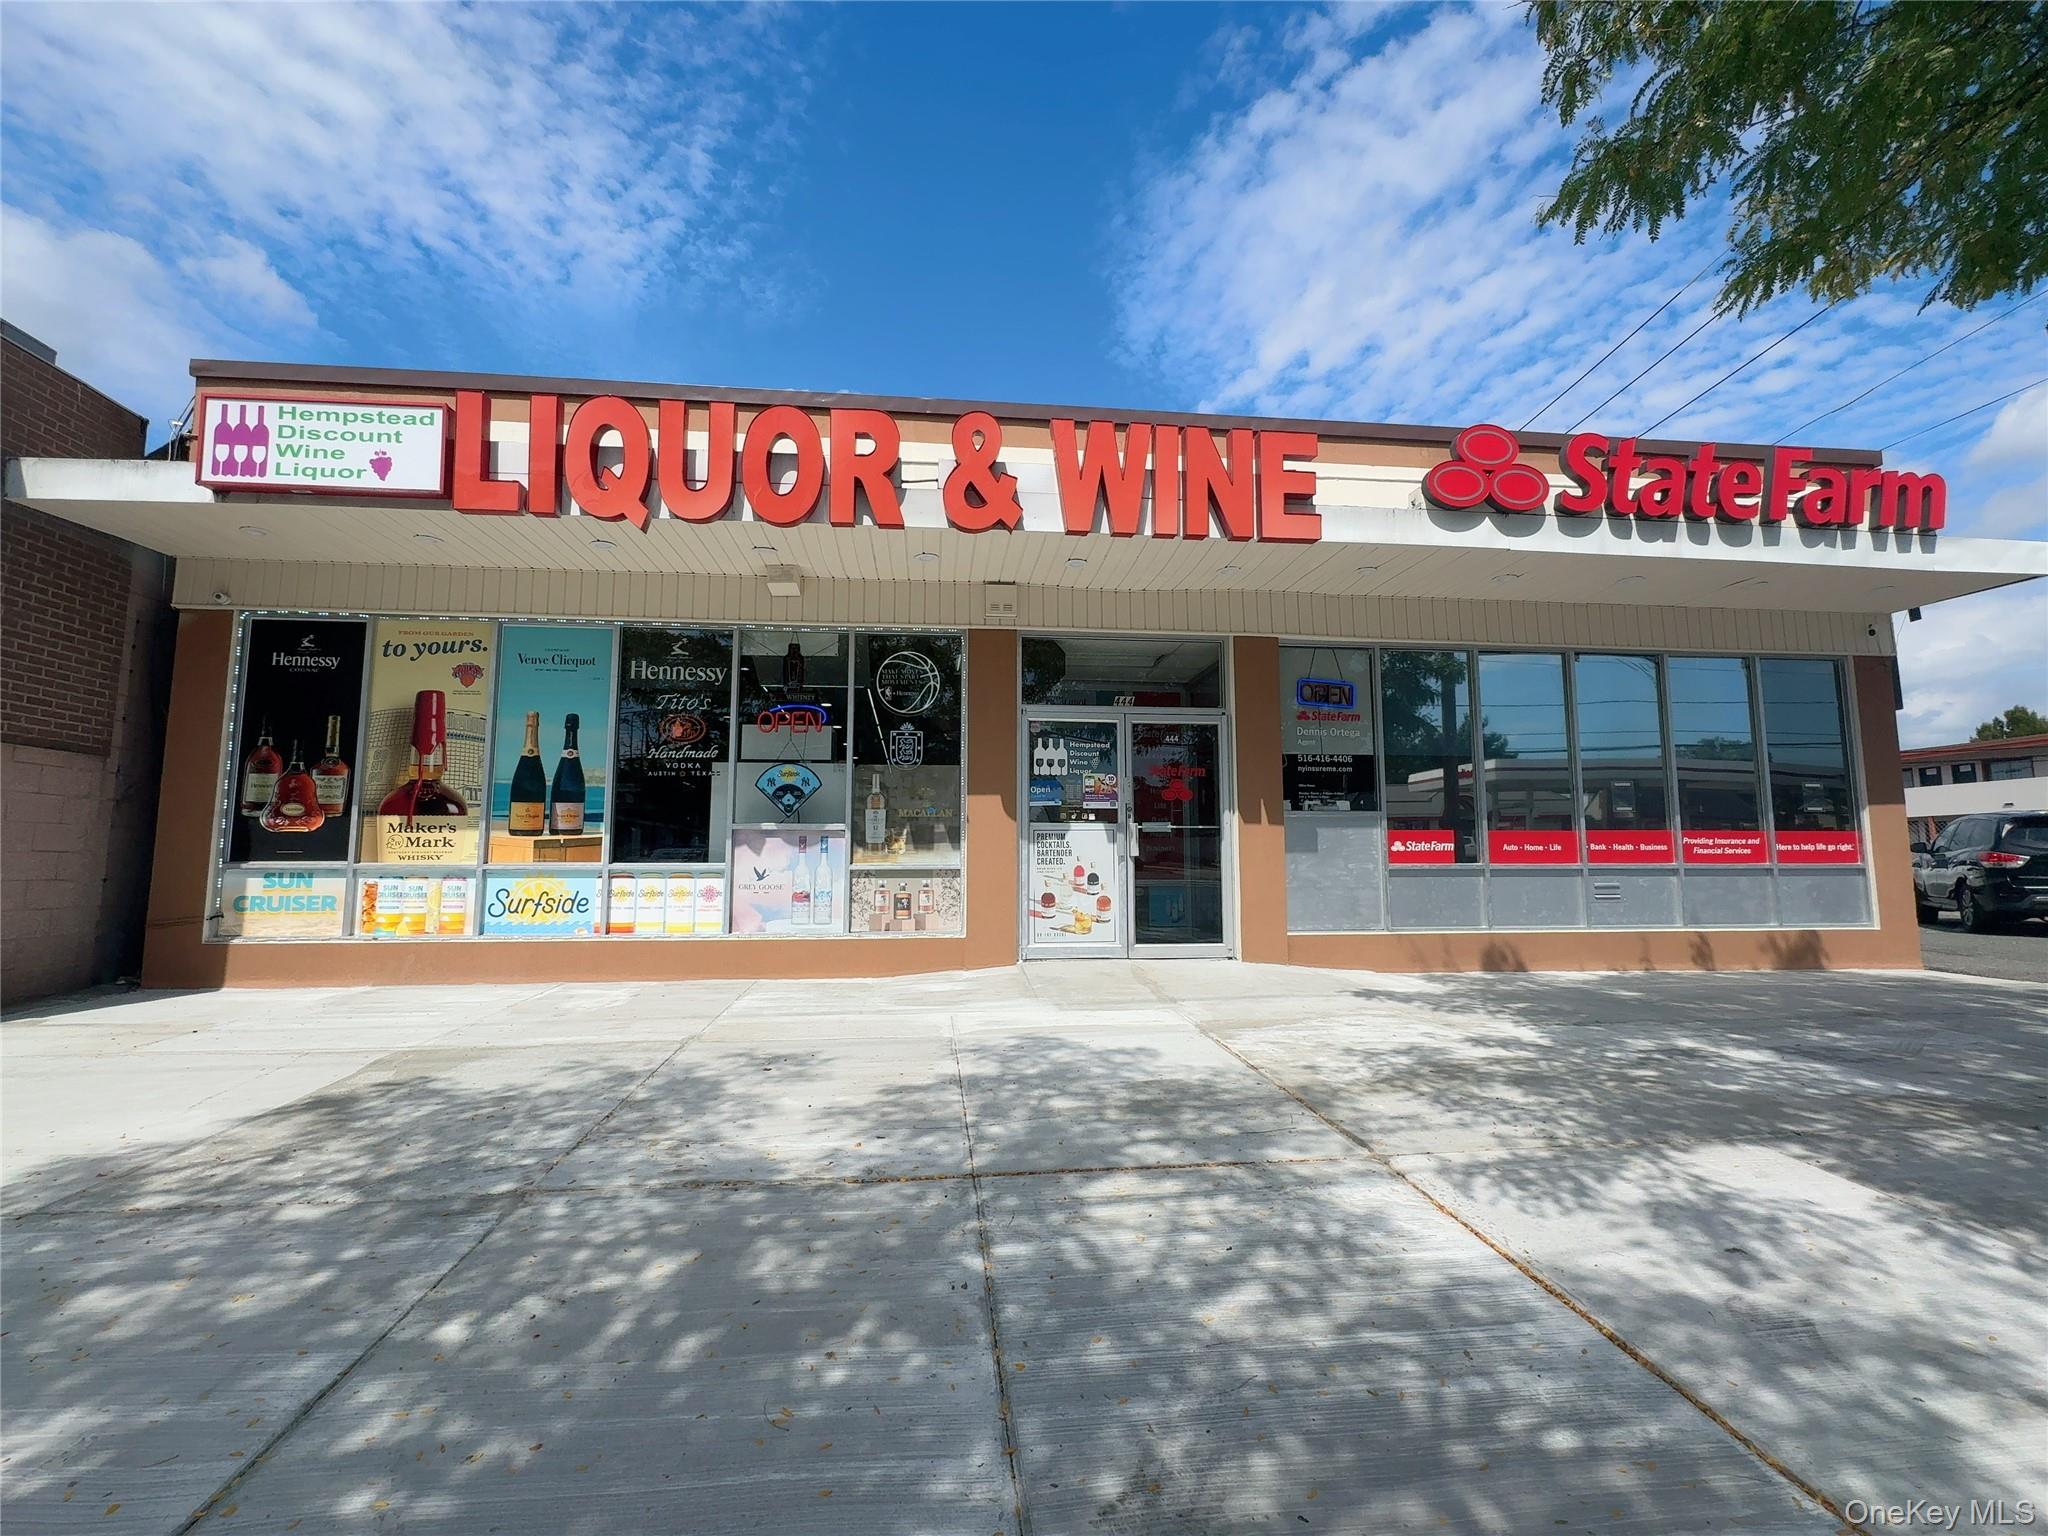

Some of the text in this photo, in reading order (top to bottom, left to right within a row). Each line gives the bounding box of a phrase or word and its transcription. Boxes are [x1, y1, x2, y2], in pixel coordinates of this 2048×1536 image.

[278, 405, 435, 427] Hempstead
[277, 425, 403, 444] Discount
[276, 443, 346, 460] Wine
[274, 462, 367, 481] Liquor
[453, 389, 1323, 545] LIQUOR & WINE
[382, 639, 488, 661] to yours.
[272, 652, 341, 670] Hennessy
[518, 653, 596, 668] Veuve Clicquot
[630, 660, 728, 686] Hennessy
[1113, 696, 1135, 706] 444
[1301, 684, 1351, 705] OPEN
[656, 693, 712, 710] Tito's
[757, 711, 823, 734] OPEN
[1297, 727, 1360, 738] Dennis Ortega
[646, 744, 719, 759] Handmade
[1069, 741, 1111, 749] Hempstead
[1298, 755, 1353, 763] 516-416-4406
[1298, 765, 1353, 773] nyinsureme.com
[1031, 786, 1051, 794] Open
[898, 808, 953, 817] MACALLAN
[386, 822, 457, 834] Maker's
[405, 836, 455, 848] Mark
[1036, 841, 1072, 849] COCKTAILS.
[1405, 840, 1454, 851] StateFarm
[1612, 843, 1634, 851] Health
[1683, 837, 1713, 845] Providing
[1801, 843, 1815, 851] help
[1036, 849, 1073, 857] BARTENDER
[1036, 857, 1066, 865] CREATED.
[263, 872, 313, 889] SUN
[233, 895, 337, 912] CRUISER
[487, 888, 590, 918] Surfside
